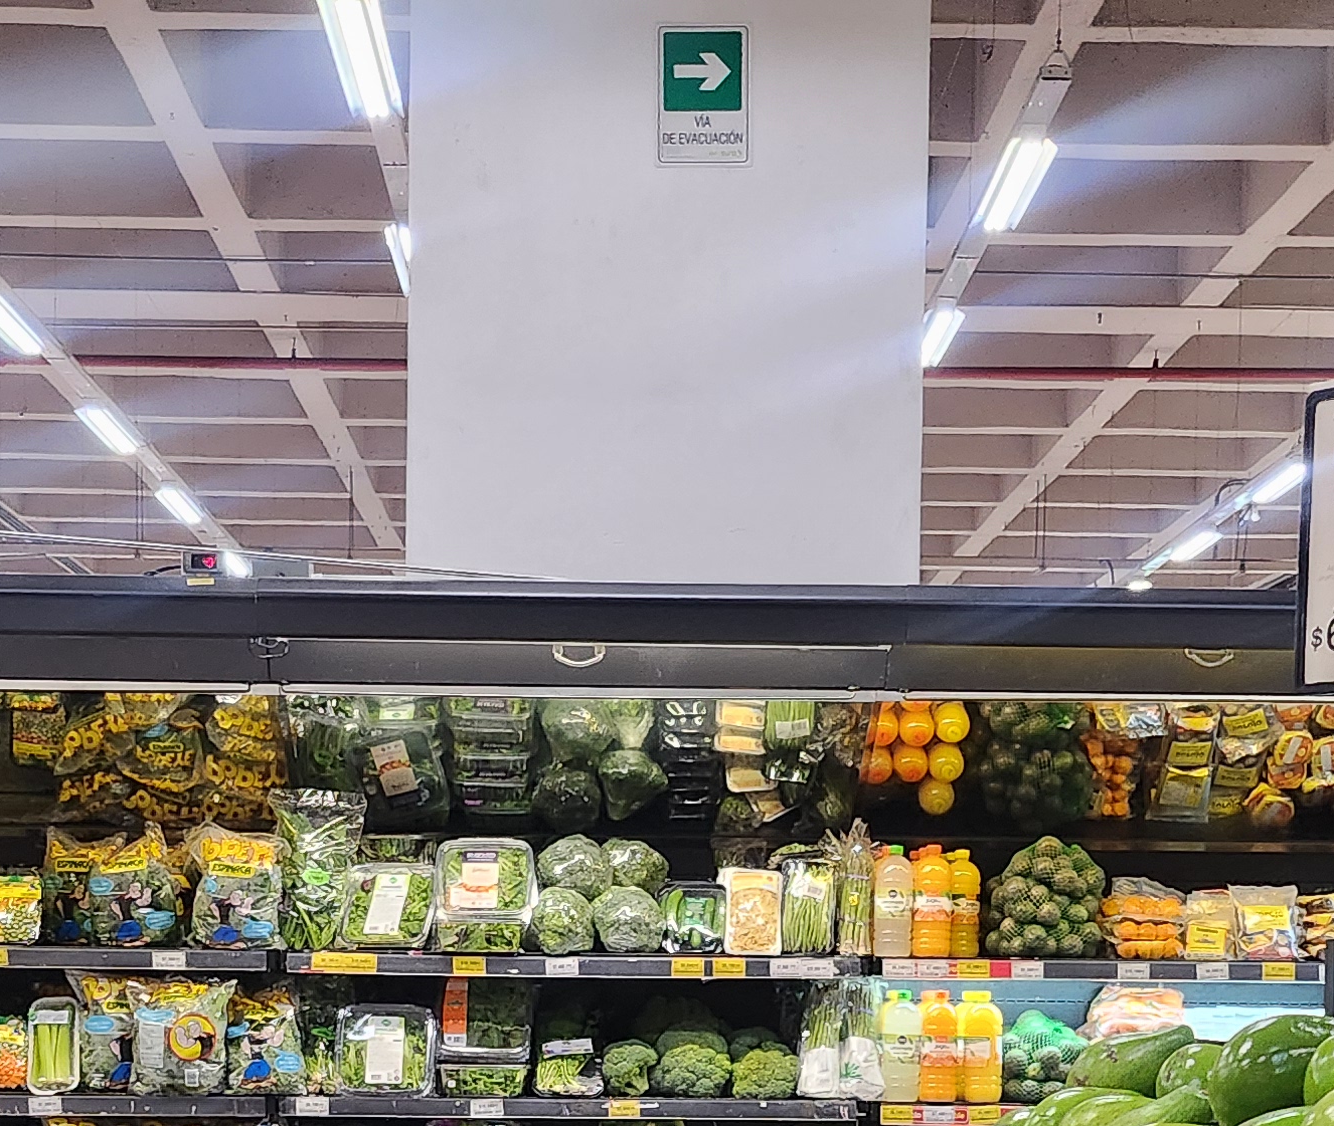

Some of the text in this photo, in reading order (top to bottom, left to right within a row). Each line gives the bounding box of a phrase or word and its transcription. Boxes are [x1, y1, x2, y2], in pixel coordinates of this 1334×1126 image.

[694, 113, 712, 128] VÍA
[662, 129, 744, 145] DE EVACUACIÓN
